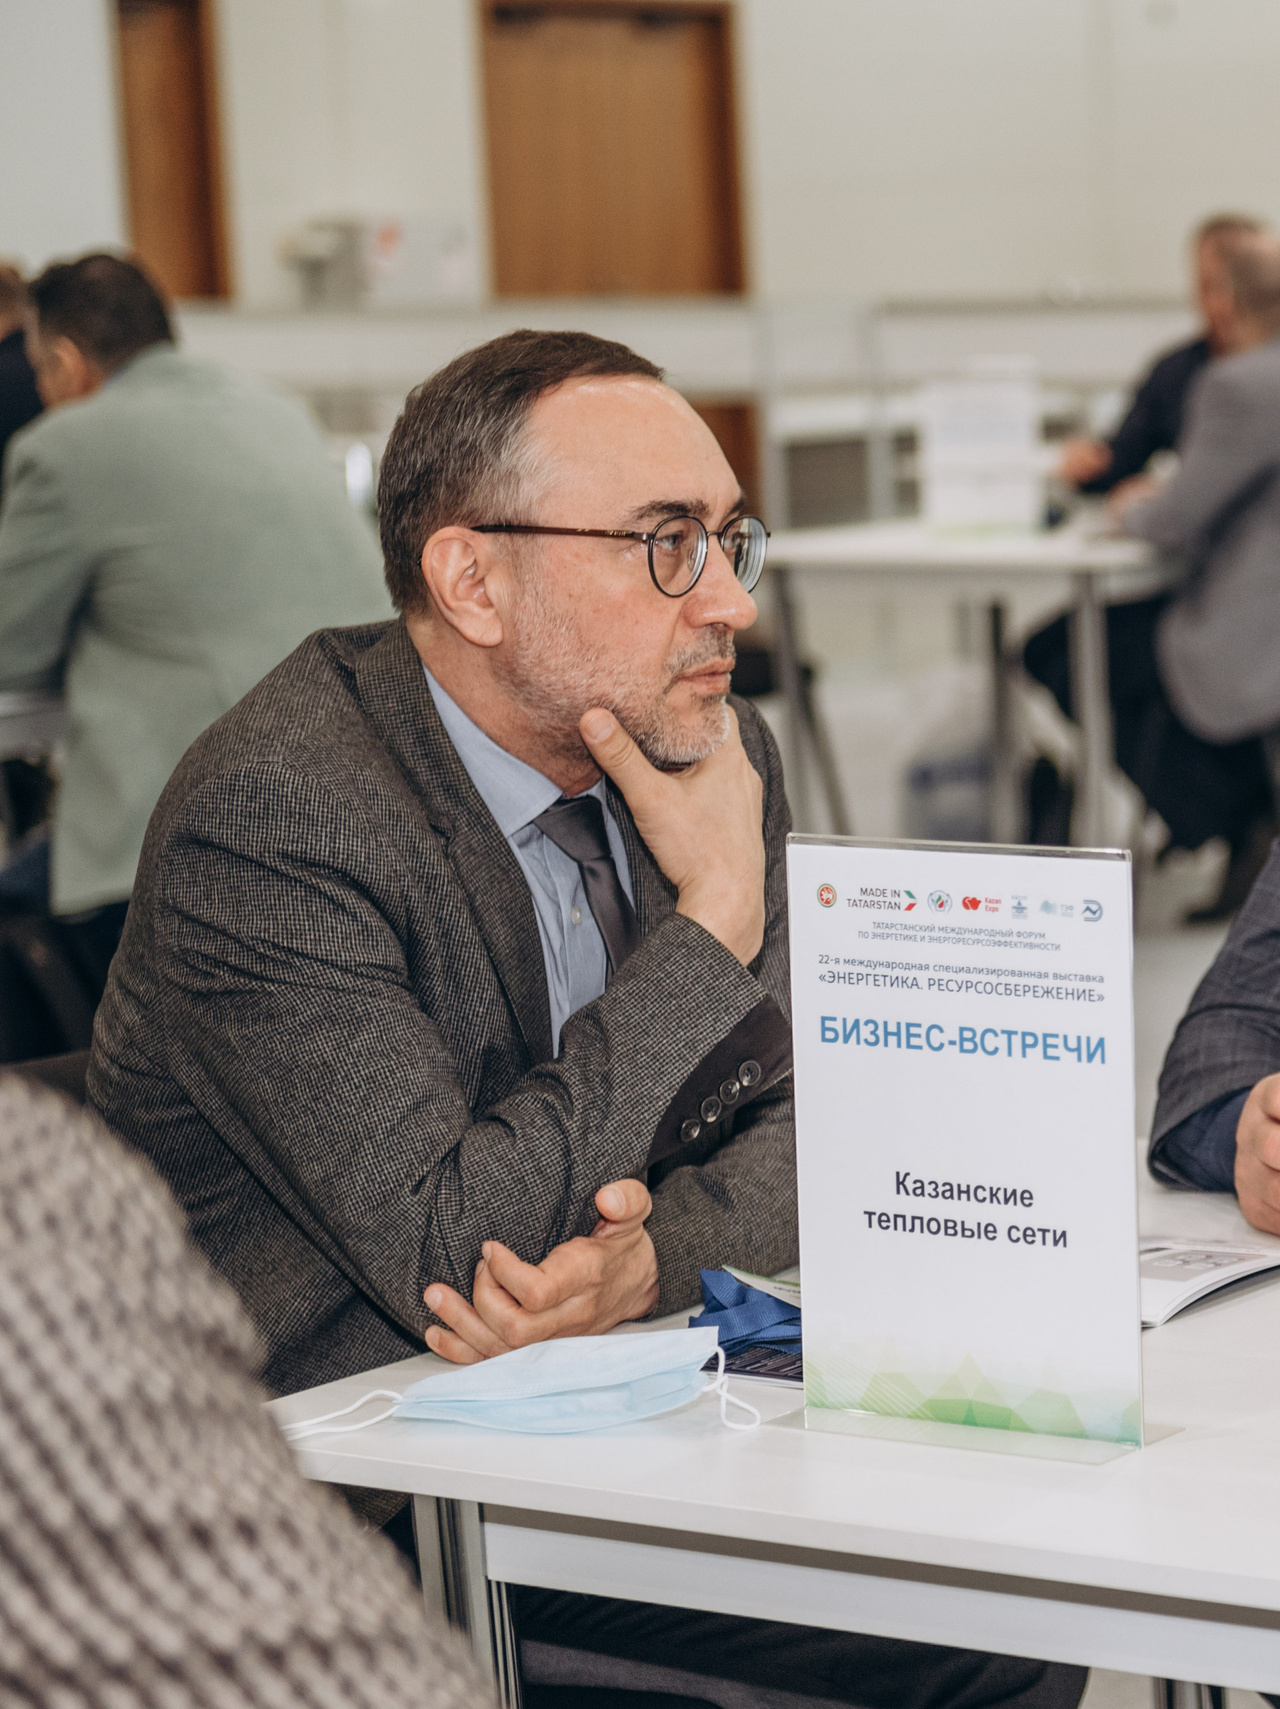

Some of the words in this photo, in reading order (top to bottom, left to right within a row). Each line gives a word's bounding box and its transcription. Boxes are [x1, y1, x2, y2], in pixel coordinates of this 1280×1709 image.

[846, 898, 901, 910] TATARSTAN
[859, 887, 888, 898] MADE
[890, 889, 901, 898] IN
[984, 905, 999, 913] Expo
[858, 930, 869, 939] ПО
[870, 931, 918, 942] ЭНЕРГЕТИКЕ
[927, 935, 1061, 951] ЭНЕРГОРЕСУРСОЭФФЕКТИВНОСТИ
[872, 921, 936, 933] ТАТАРСТАНСКИЙ
[937, 925, 1014, 938] МЕЖДУНАРОДНЫЙ
[1015, 930, 1046, 940] ФОРУМ
[818, 954, 841, 965] 22-я
[843, 956, 930, 972] международная
[932, 963, 1049, 980] специализированная
[1052, 972, 1105, 984] выставка
[818, 970, 924, 990] «ЭНЕРГЕТИКА.
[927, 979, 1105, 1003] РЕСУРСОСБЕРЕЖЕНИЕ»
[819, 1015, 1107, 1065] БИЗНЕС-ВСТРЕЧИ
[895, 1170, 1035, 1209] Казанские
[863, 1209, 998, 1242] тепловые
[1006, 1224, 1068, 1249] сети
